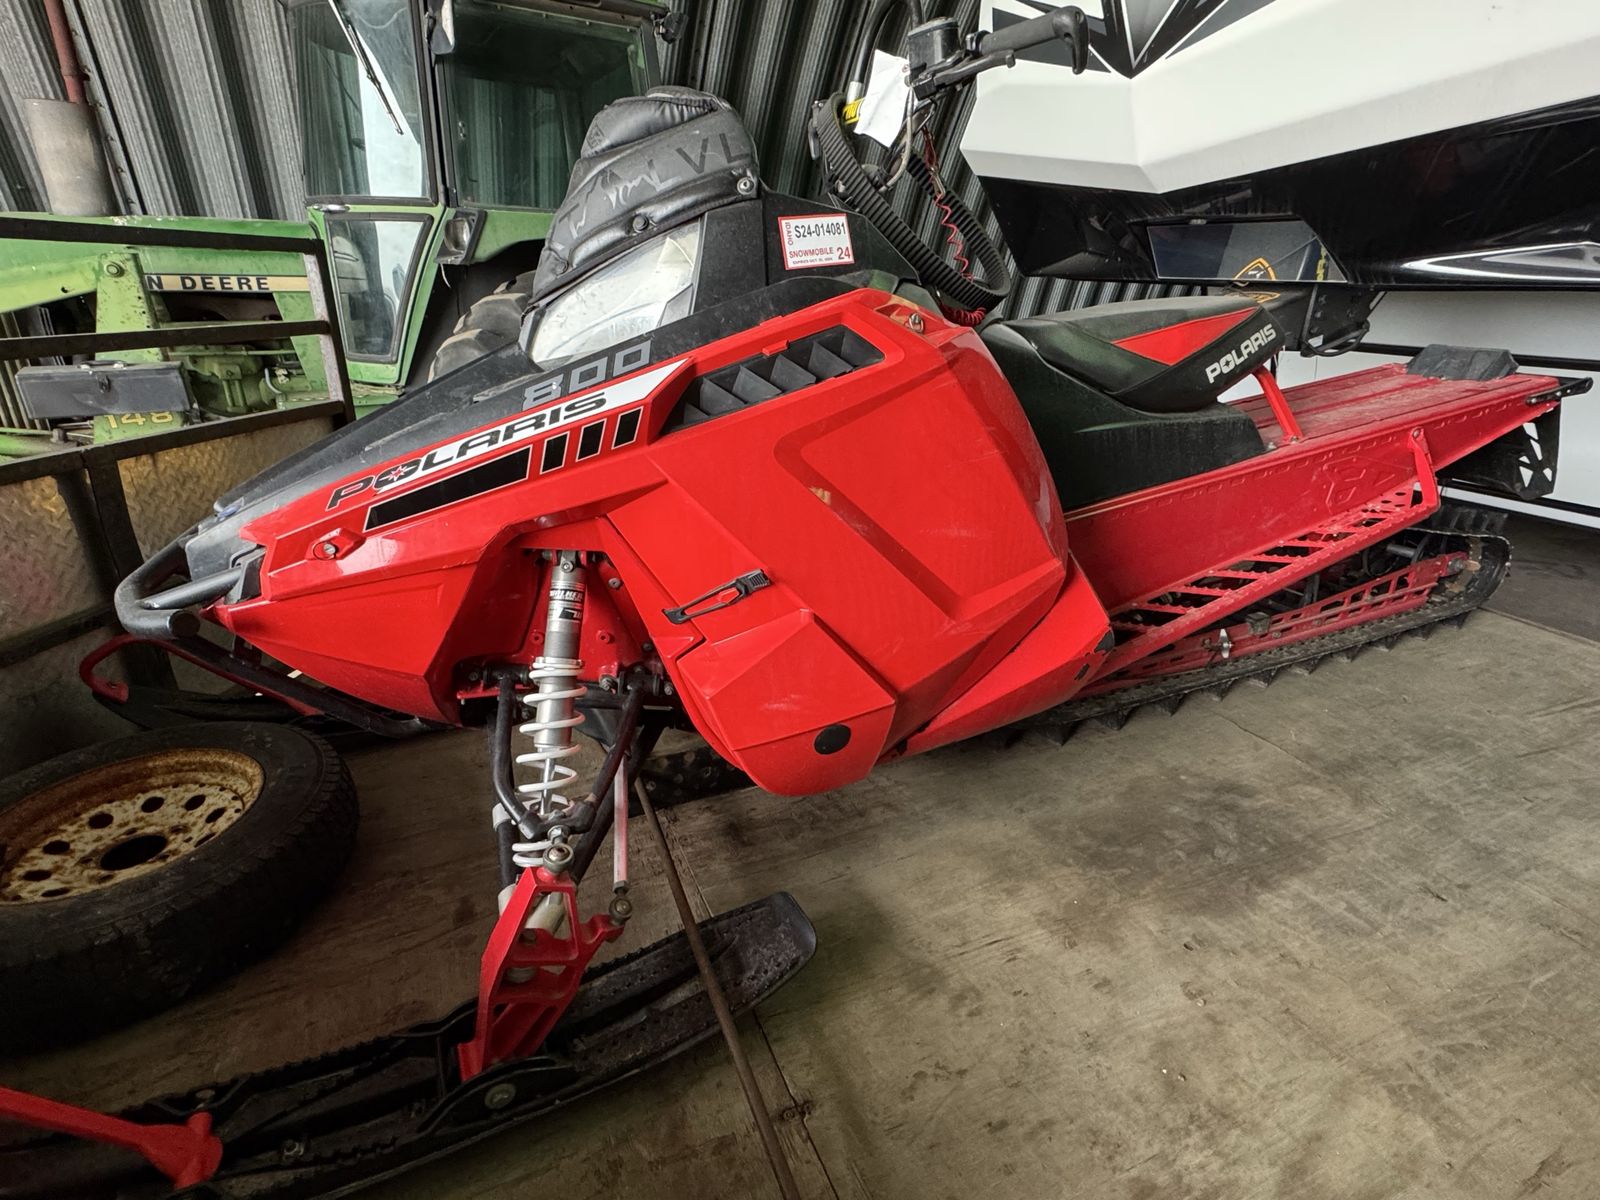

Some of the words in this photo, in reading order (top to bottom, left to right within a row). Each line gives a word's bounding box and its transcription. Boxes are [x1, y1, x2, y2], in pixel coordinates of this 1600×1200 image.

[785, 222, 794, 246] IDAHO
[794, 222, 846, 239] S24-014081
[789, 247, 834, 259] SNOWMOBILE
[836, 246, 851, 260] 24
[180, 276, 270, 290] DEERE
[1205, 323, 1277, 384] POLARIS
[522, 340, 651, 411] 800
[326, 391, 608, 511] POLARIS
